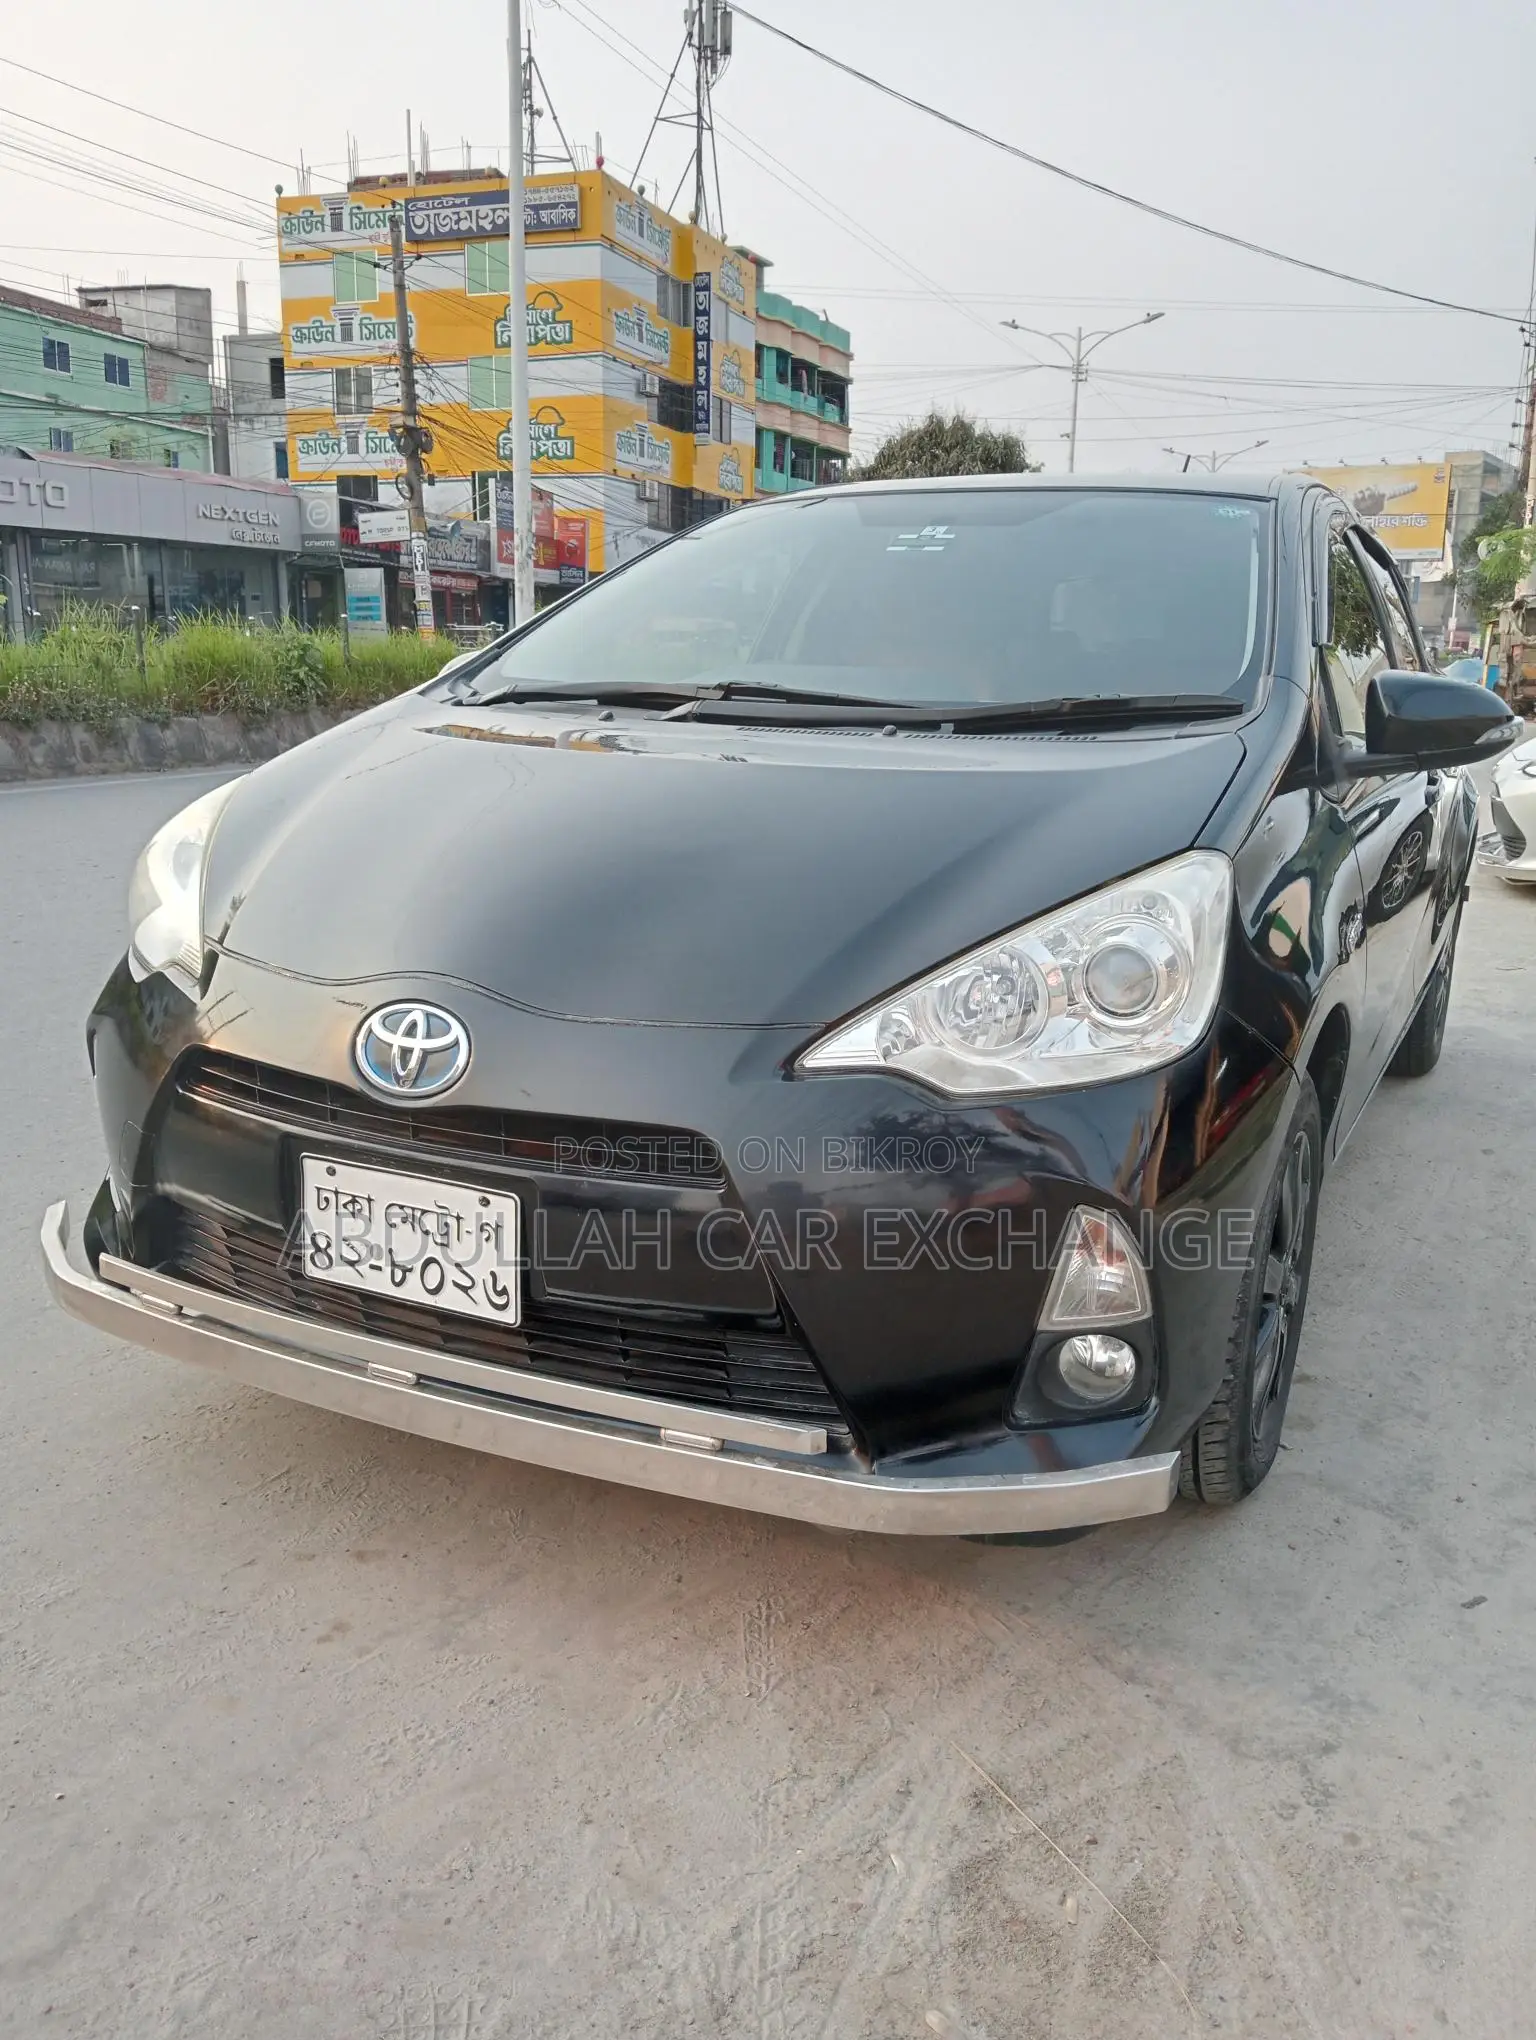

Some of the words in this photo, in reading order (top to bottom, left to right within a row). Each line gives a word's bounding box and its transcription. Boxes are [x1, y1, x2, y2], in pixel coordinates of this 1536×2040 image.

[407, 196, 471, 211] হোটেল
[539, 203, 577, 225] আবাসিক
[282, 208, 325, 235] ক্রাউন
[292, 319, 337, 344] ক্রাউন
[299, 431, 342, 455] ক্রাউন
[197, 503, 280, 528] NEXTGEN
[304, 540, 336, 552] CFMOTO
[314, 1185, 376, 1224] ঢাকা
[309, 1230, 511, 1312] ৪২-৮০২৬
